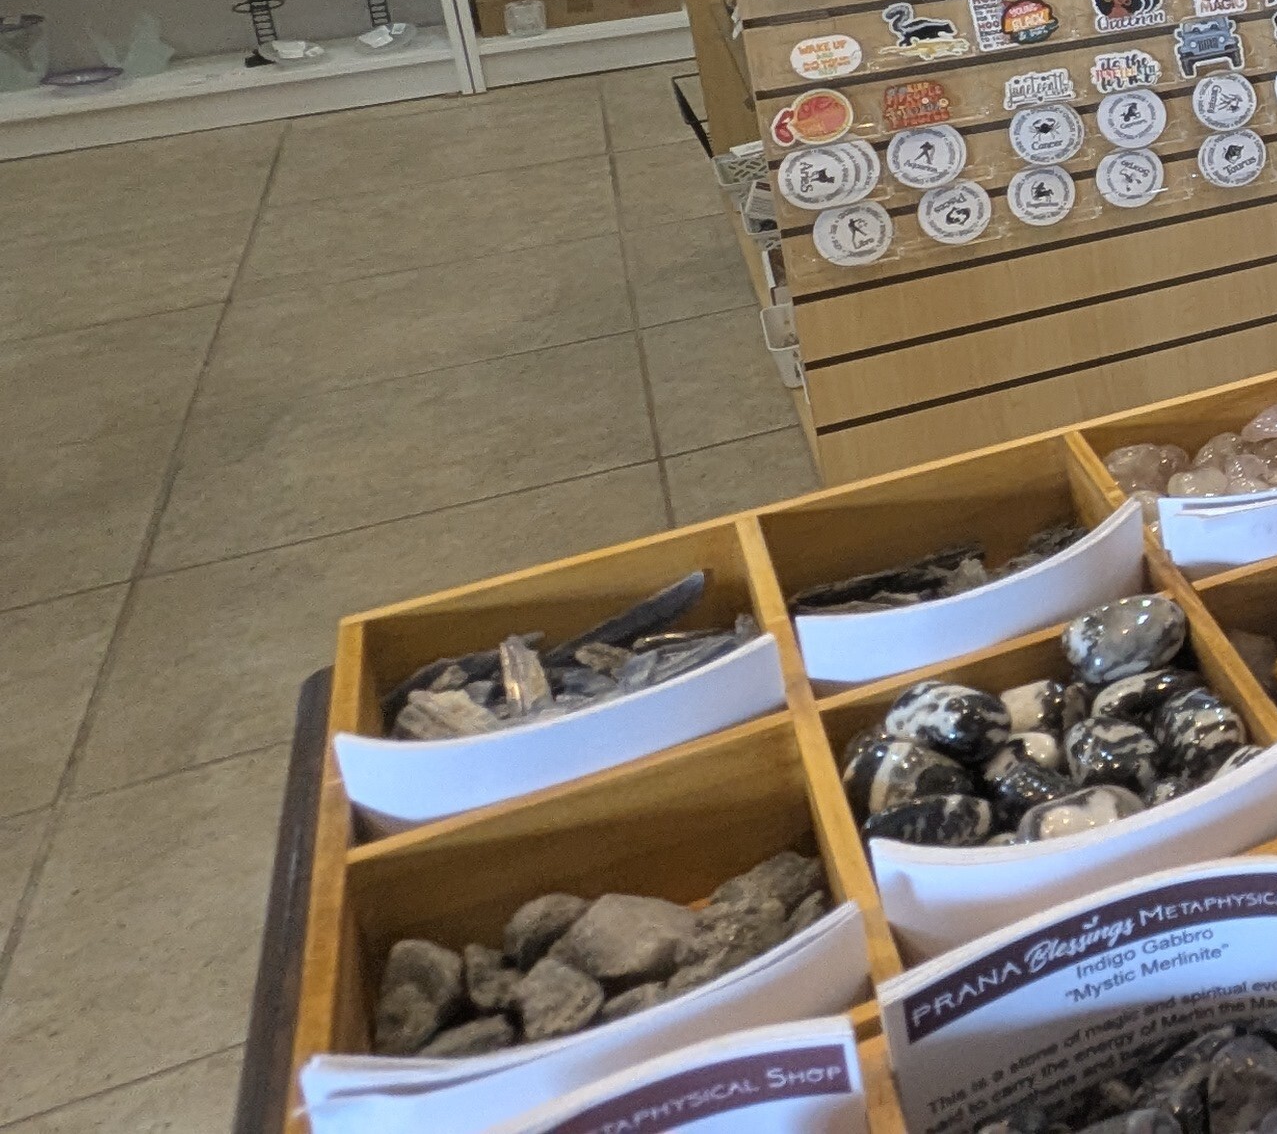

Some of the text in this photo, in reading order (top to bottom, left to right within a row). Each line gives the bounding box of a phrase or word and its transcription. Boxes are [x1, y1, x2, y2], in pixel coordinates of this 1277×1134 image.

[1031, 140, 1063, 151] Cancer
[1065, 942, 1230, 1004] "Mystic Merlinite"
[1076, 926, 1215, 980] Indigo Gabbro
[911, 961, 1023, 1028] PRANA
[1182, 980, 1247, 1008] spiritual
[766, 1065, 843, 1091] SHOP
